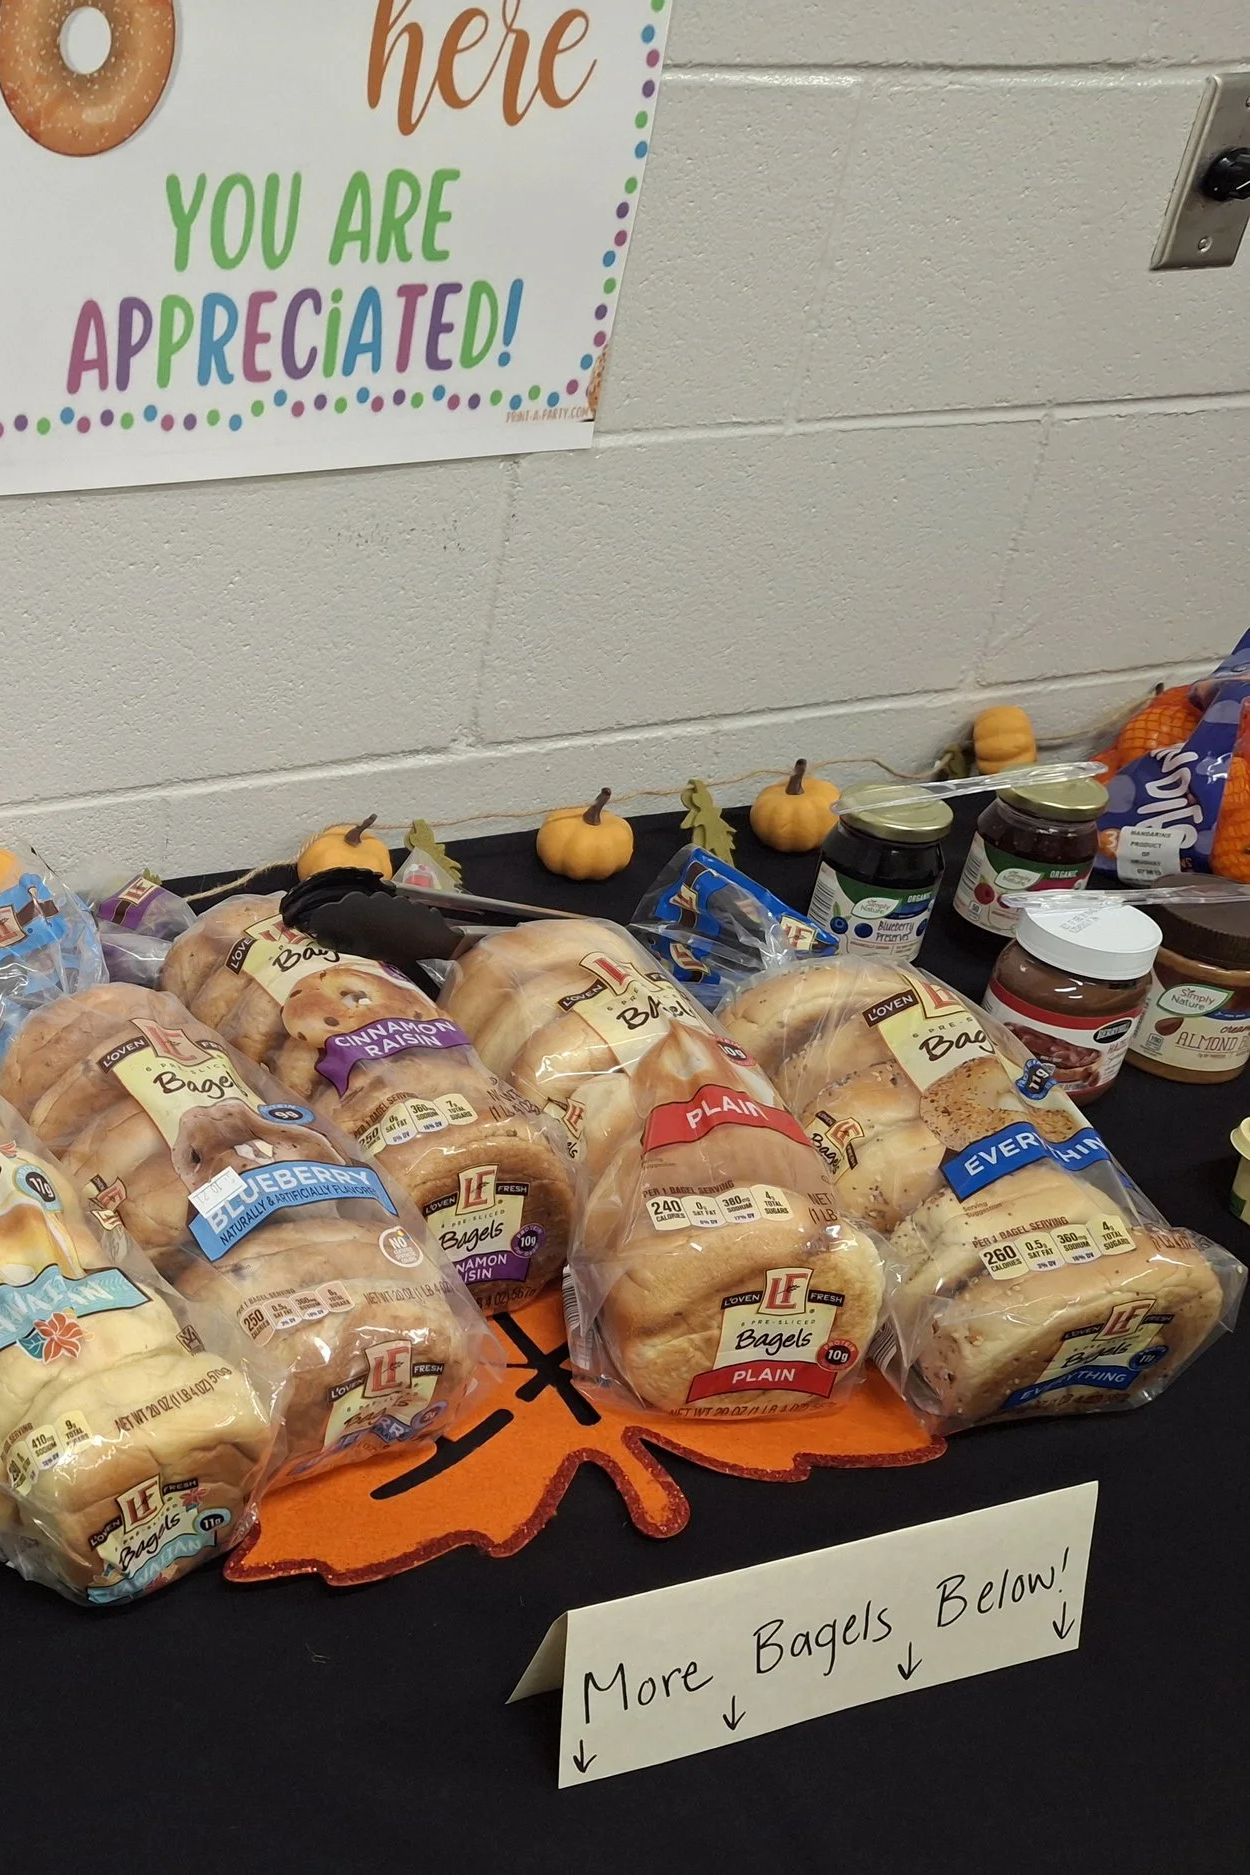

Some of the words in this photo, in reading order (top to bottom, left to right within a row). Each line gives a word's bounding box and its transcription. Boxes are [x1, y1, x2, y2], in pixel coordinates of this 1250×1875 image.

[367, 0, 597, 136] here
[166, 171, 302, 272] YOU
[328, 168, 461, 266] ARE
[877, 920, 915, 934] Blueberry
[231, 938, 252, 969] L'OVE
[272, 946, 340, 972] Bag
[563, 984, 603, 1007] L'OVEN
[1171, 994, 1205, 1010] Nature
[1181, 988, 1216, 1004] Simply
[867, 993, 914, 1022] L'OVEN
[334, 1021, 457, 1047] CINNAMON
[364, 1033, 442, 1056] RAISIN
[1176, 1032, 1238, 1051] ALMOND
[102, 1039, 147, 1068] L'OVEN
[919, 1030, 995, 1062] Bag
[274, 1110, 299, 1120] 9g
[685, 1094, 768, 1129] PLAIN
[964, 1132, 1105, 1177] EVERHIN
[29, 1177, 55, 1198] 11g
[669, 1186, 695, 1194] BAGEL
[699, 1180, 735, 1194] SERVING
[207, 1166, 371, 1235] BLUEBERRY
[425, 1197, 456, 1214] L'OVEN
[497, 1185, 527, 1193] FRESH
[651, 1200, 682, 1215] 240
[807, 1192, 832, 1206] NET
[220, 1204, 267, 1246] NATURALLY
[266, 1196, 275, 1206] &
[274, 1184, 331, 1203] ARTIFICIALLY
[656, 1212, 686, 1222] CALORIES
[727, 1203, 753, 1213] SODIUM
[764, 1207, 789, 1215] SUGARS
[388, 1236, 407, 1250] NO
[438, 1220, 504, 1252] Bagels
[520, 1236, 536, 1247] 10g
[972, 1238, 991, 1249] PER
[1000, 1226, 1028, 1240] BAGEL
[1029, 1216, 1069, 1231] SERVING
[983, 1245, 1017, 1265] 260
[990, 1258, 1022, 1272] CALORIES
[1028, 1250, 1041, 1259] SAT
[1042, 1248, 1054, 1257] FAT
[1063, 1241, 1091, 1252] SODIUM
[1102, 1231, 1123, 1242] TOTAL
[456, 1254, 507, 1273] NAMON
[464, 1268, 492, 1282] ISIN
[724, 1293, 761, 1306] L'OVEN
[810, 1292, 843, 1303] FRESH
[243, 1309, 265, 1331] 250
[735, 1328, 813, 1356] Bagels
[827, 1350, 849, 1363] 10g
[414, 1365, 443, 1374] FRESH
[732, 1368, 796, 1384] PLAIN
[114, 1416, 134, 1432] NET
[131, 1408, 149, 1425] WT
[145, 1401, 161, 1418] 20
[157, 1396, 173, 1412] OZ
[180, 1388, 193, 1403] LB
[189, 1385, 199, 1397] 4
[195, 1379, 214, 1395] OZ)
[65, 1427, 84, 1440] TOTAL
[90, 1520, 121, 1546] L'OVEN
[164, 1480, 197, 1494] FRESH
[118, 1512, 180, 1572] Bagels
[583, 1661, 713, 1724] More
[752, 1600, 893, 1676] Bagels
[935, 1546, 1070, 1628] Below!
